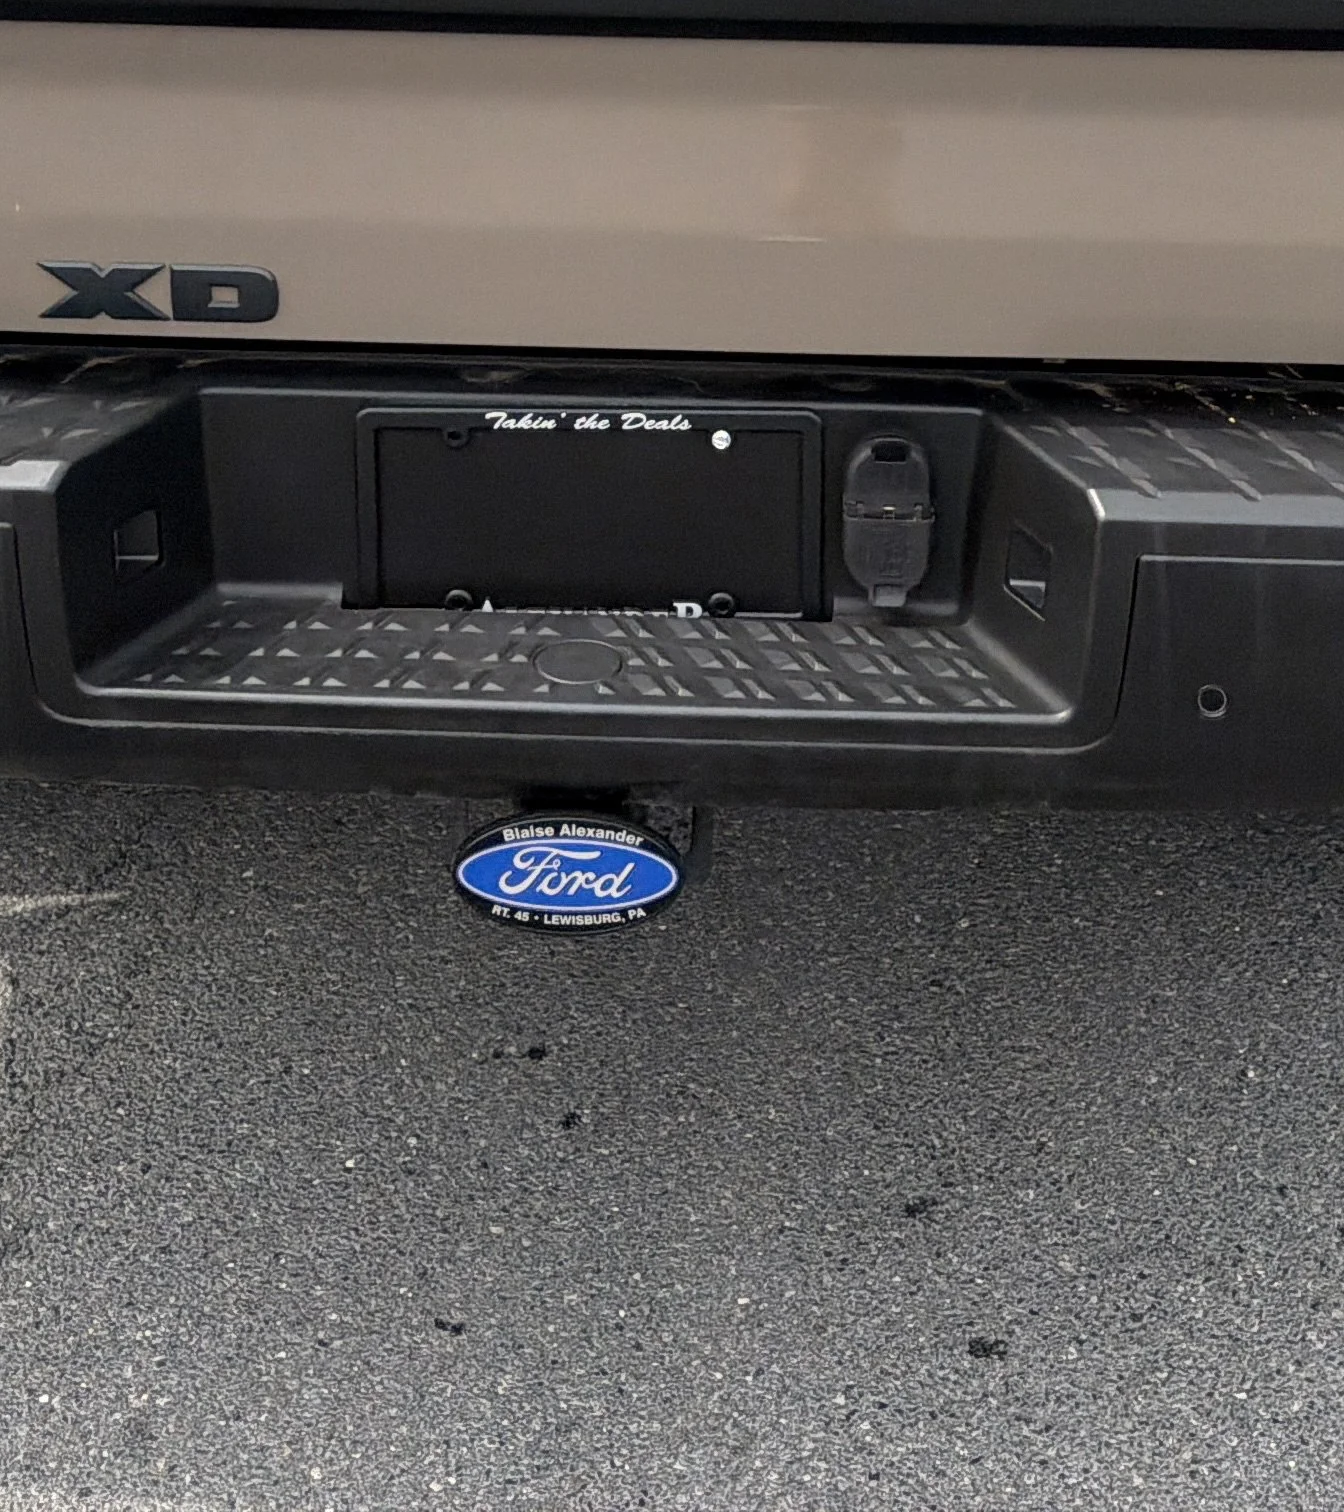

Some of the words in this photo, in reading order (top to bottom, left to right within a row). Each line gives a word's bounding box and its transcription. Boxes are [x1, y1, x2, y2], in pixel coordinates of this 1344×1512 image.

[36, 257, 280, 324] XD
[484, 411, 567, 431] Takin'
[573, 413, 611, 431] the
[620, 412, 693, 431] Deals
[502, 825, 555, 843] Blaise
[559, 823, 645, 847] Alexander
[498, 846, 636, 899] Ford
[491, 904, 511, 919] RT.
[514, 909, 530, 922] 45
[543, 913, 626, 926] LEWISBURG,
[628, 906, 647, 920] PA
